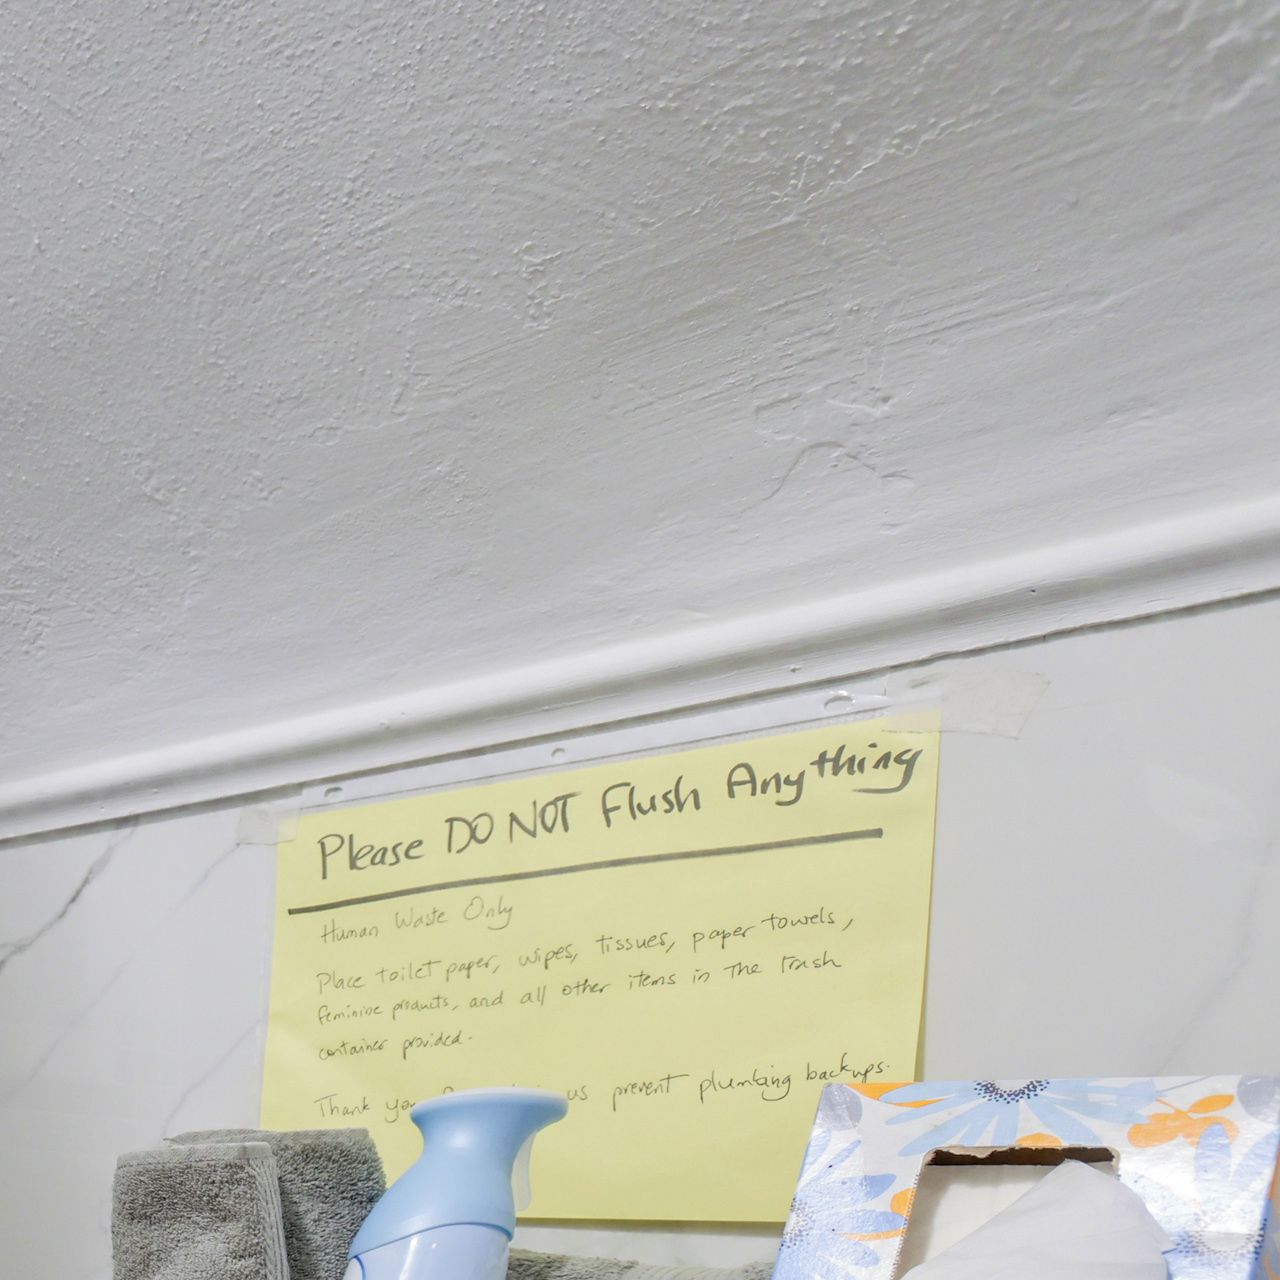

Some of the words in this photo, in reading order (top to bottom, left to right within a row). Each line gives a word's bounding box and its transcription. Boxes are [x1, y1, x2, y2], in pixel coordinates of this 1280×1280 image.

[317, 833, 425, 880] Please
[444, 812, 494, 854] DO
[508, 790, 583, 844] NOT
[601, 774, 701, 829] Flush
[320, 918, 379, 944] Human
[394, 906, 449, 930] Waste
[463, 895, 514, 931] Only
[316, 971, 366, 996] Place
[375, 959, 443, 983] toilet
[445, 953, 501, 983] paper,
[518, 941, 579, 971] wipes,
[595, 930, 676, 954] tissues,
[692, 924, 756, 953] paper
[468, 990, 504, 1008] and
[519, 985, 547, 1007] all
[561, 978, 611, 997] other
[628, 970, 677, 990] items
[692, 968, 711, 985] in
[780, 950, 842, 974] trash
[318, 1037, 389, 1061] container
[314, 1092, 371, 1118] Thank
[567, 1084, 589, 1101] us
[612, 1073, 690, 1112] prevent
[699, 1064, 792, 1102] plumbing
